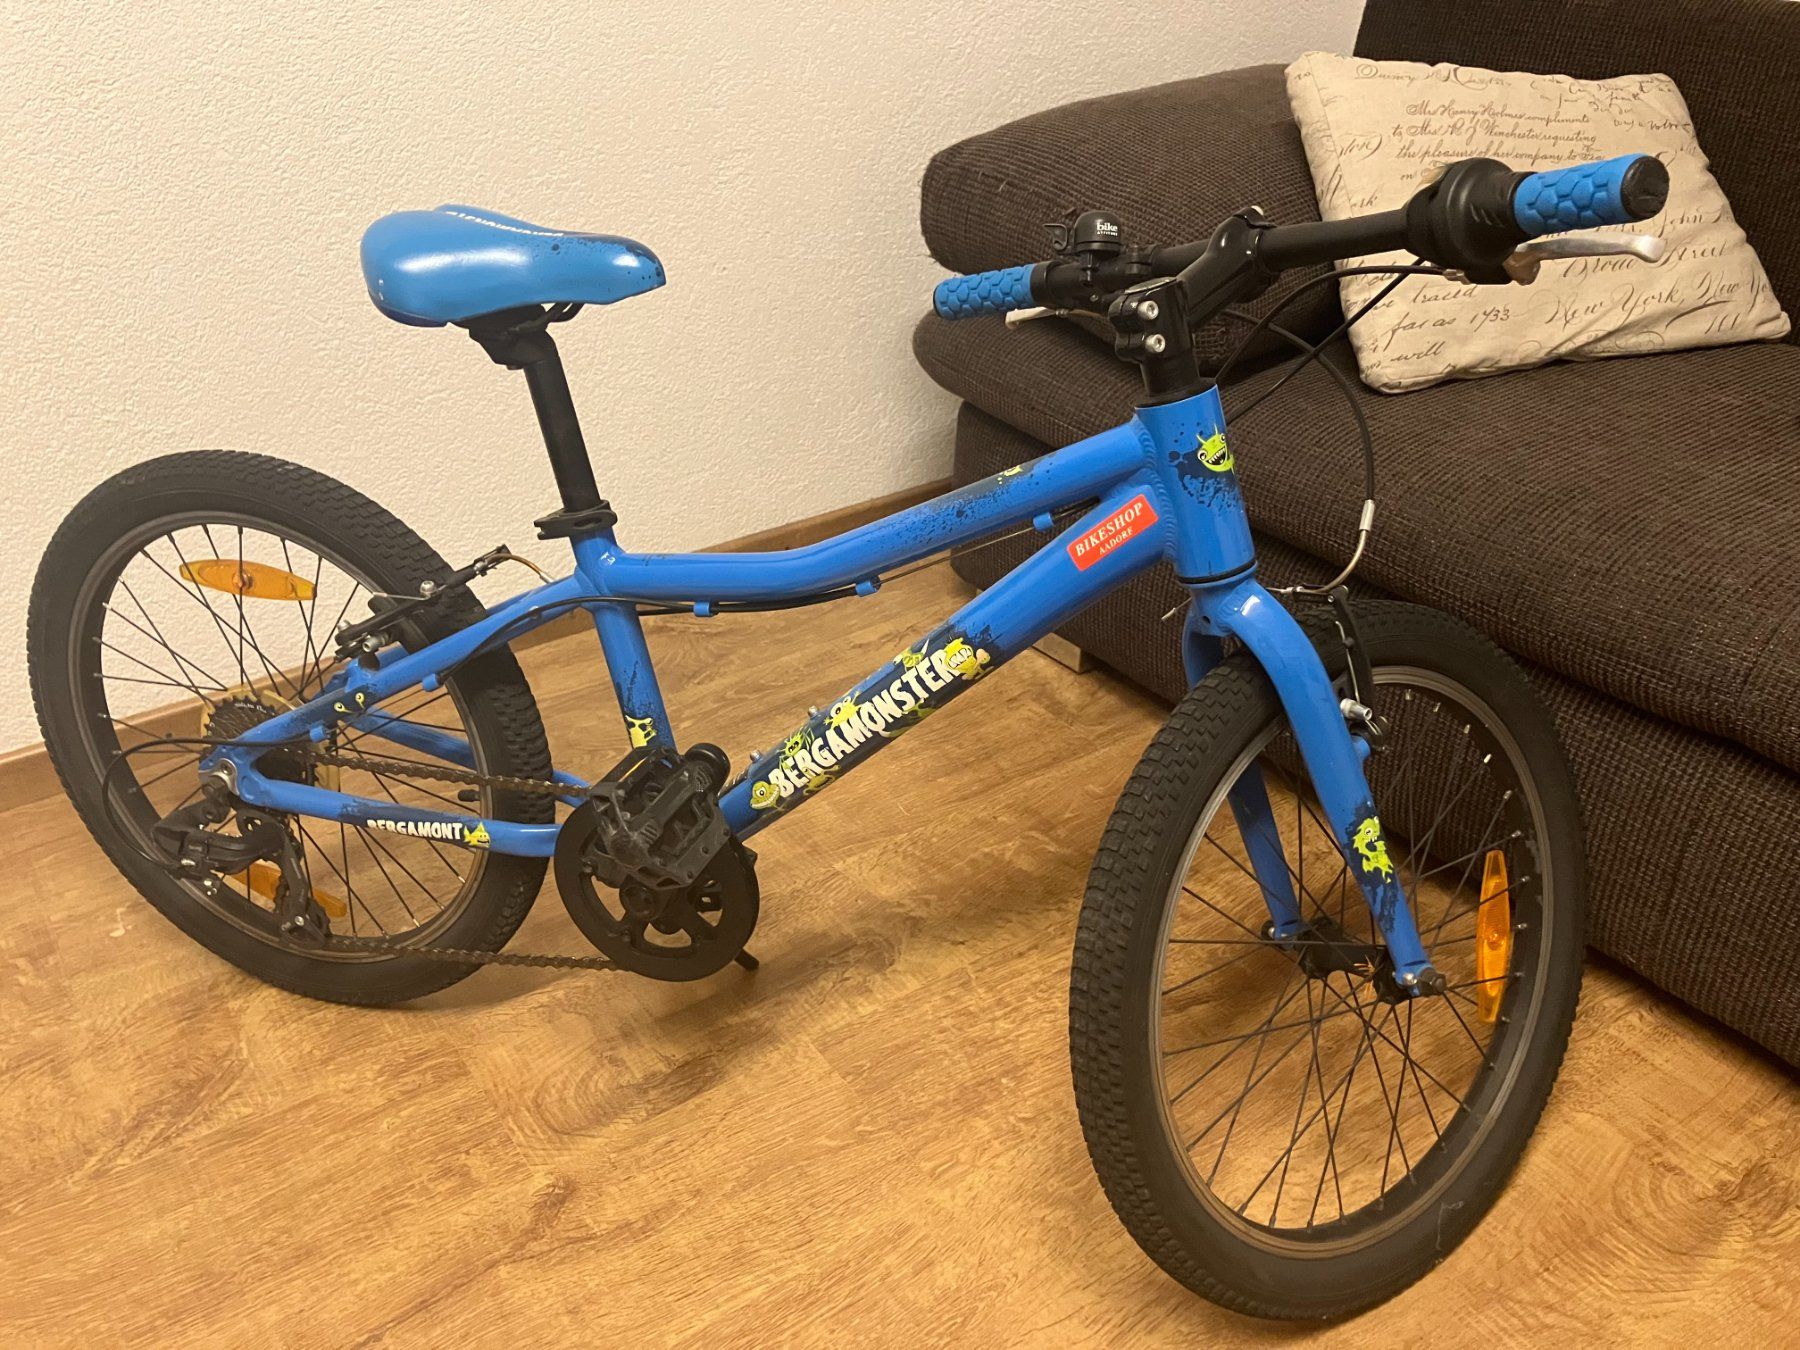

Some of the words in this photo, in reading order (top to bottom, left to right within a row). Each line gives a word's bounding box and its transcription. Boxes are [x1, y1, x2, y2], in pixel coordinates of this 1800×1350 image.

[1525, 109, 1589, 127] compliments
[1542, 129, 1596, 147] requesting
[1513, 147, 1564, 167] company
[1096, 221, 1118, 232] bike
[1075, 502, 1143, 557] BIKESHOP
[768, 648, 963, 798] BERGAMONSTER
